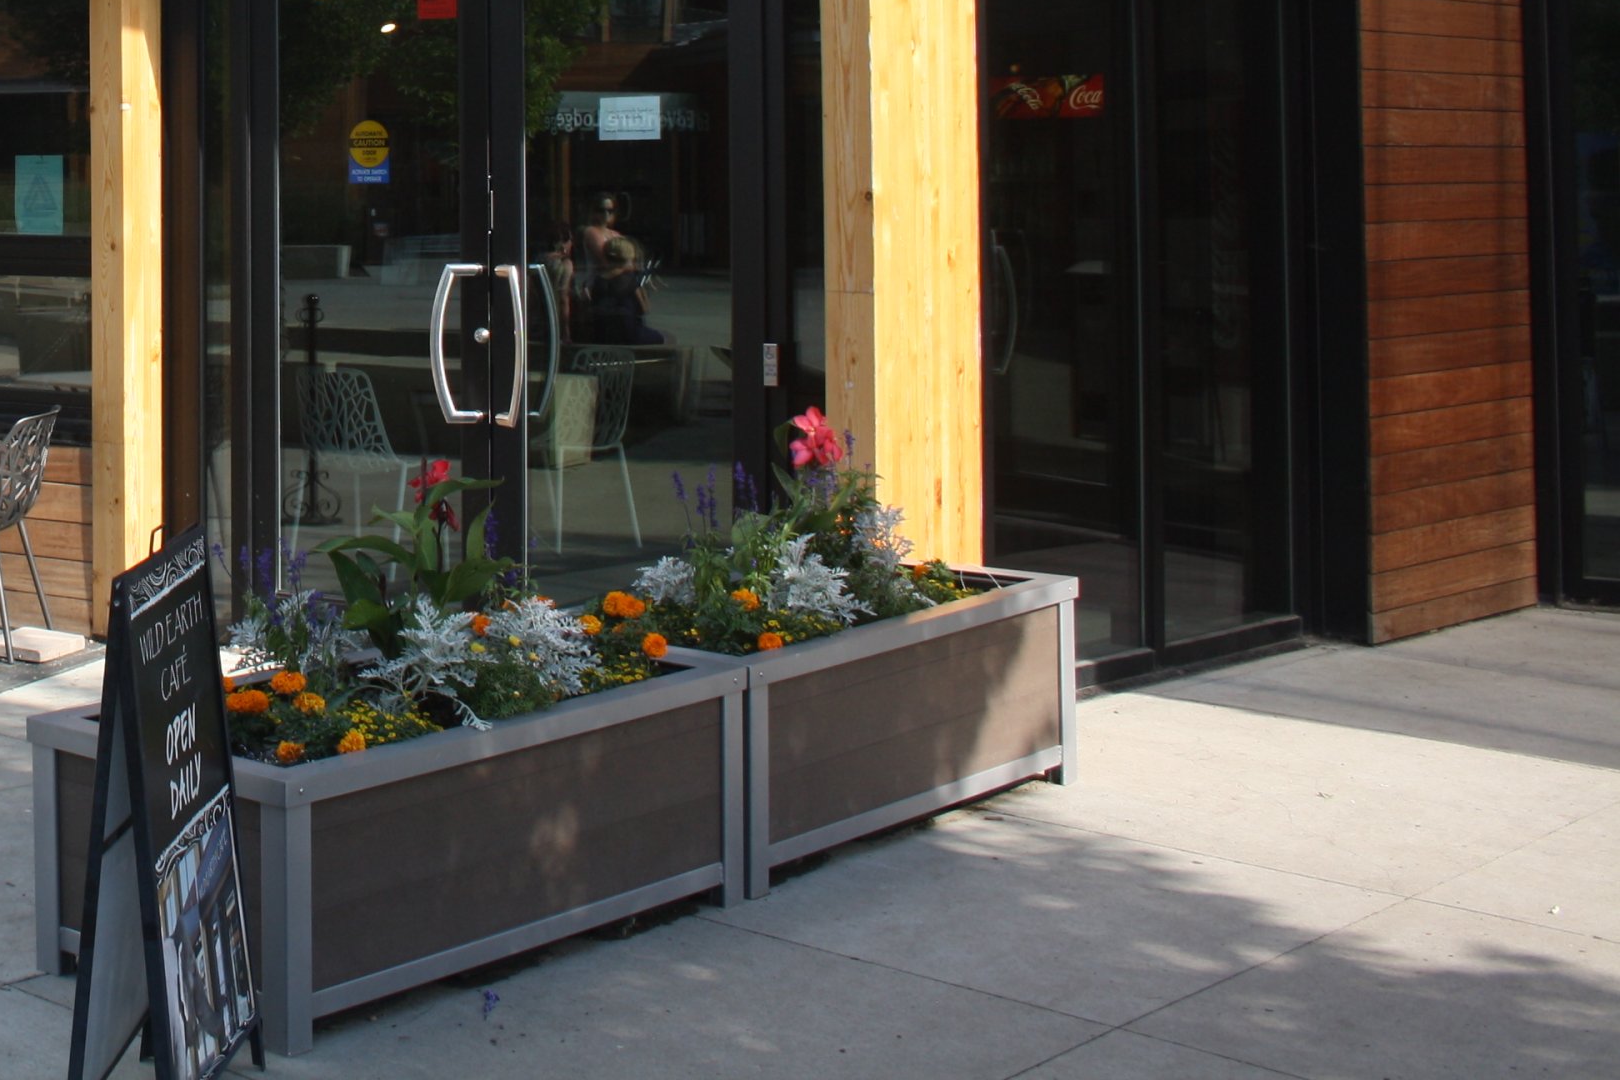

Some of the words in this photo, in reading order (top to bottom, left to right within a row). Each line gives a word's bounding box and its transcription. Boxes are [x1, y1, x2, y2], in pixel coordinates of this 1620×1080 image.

[352, 138, 386, 147] CAUTION
[139, 621, 164, 666] WILD
[166, 591, 203, 646] EARTH
[160, 644, 192, 701] CAFÉ
[166, 702, 197, 766] OPEN
[169, 751, 202, 820] DAILY
